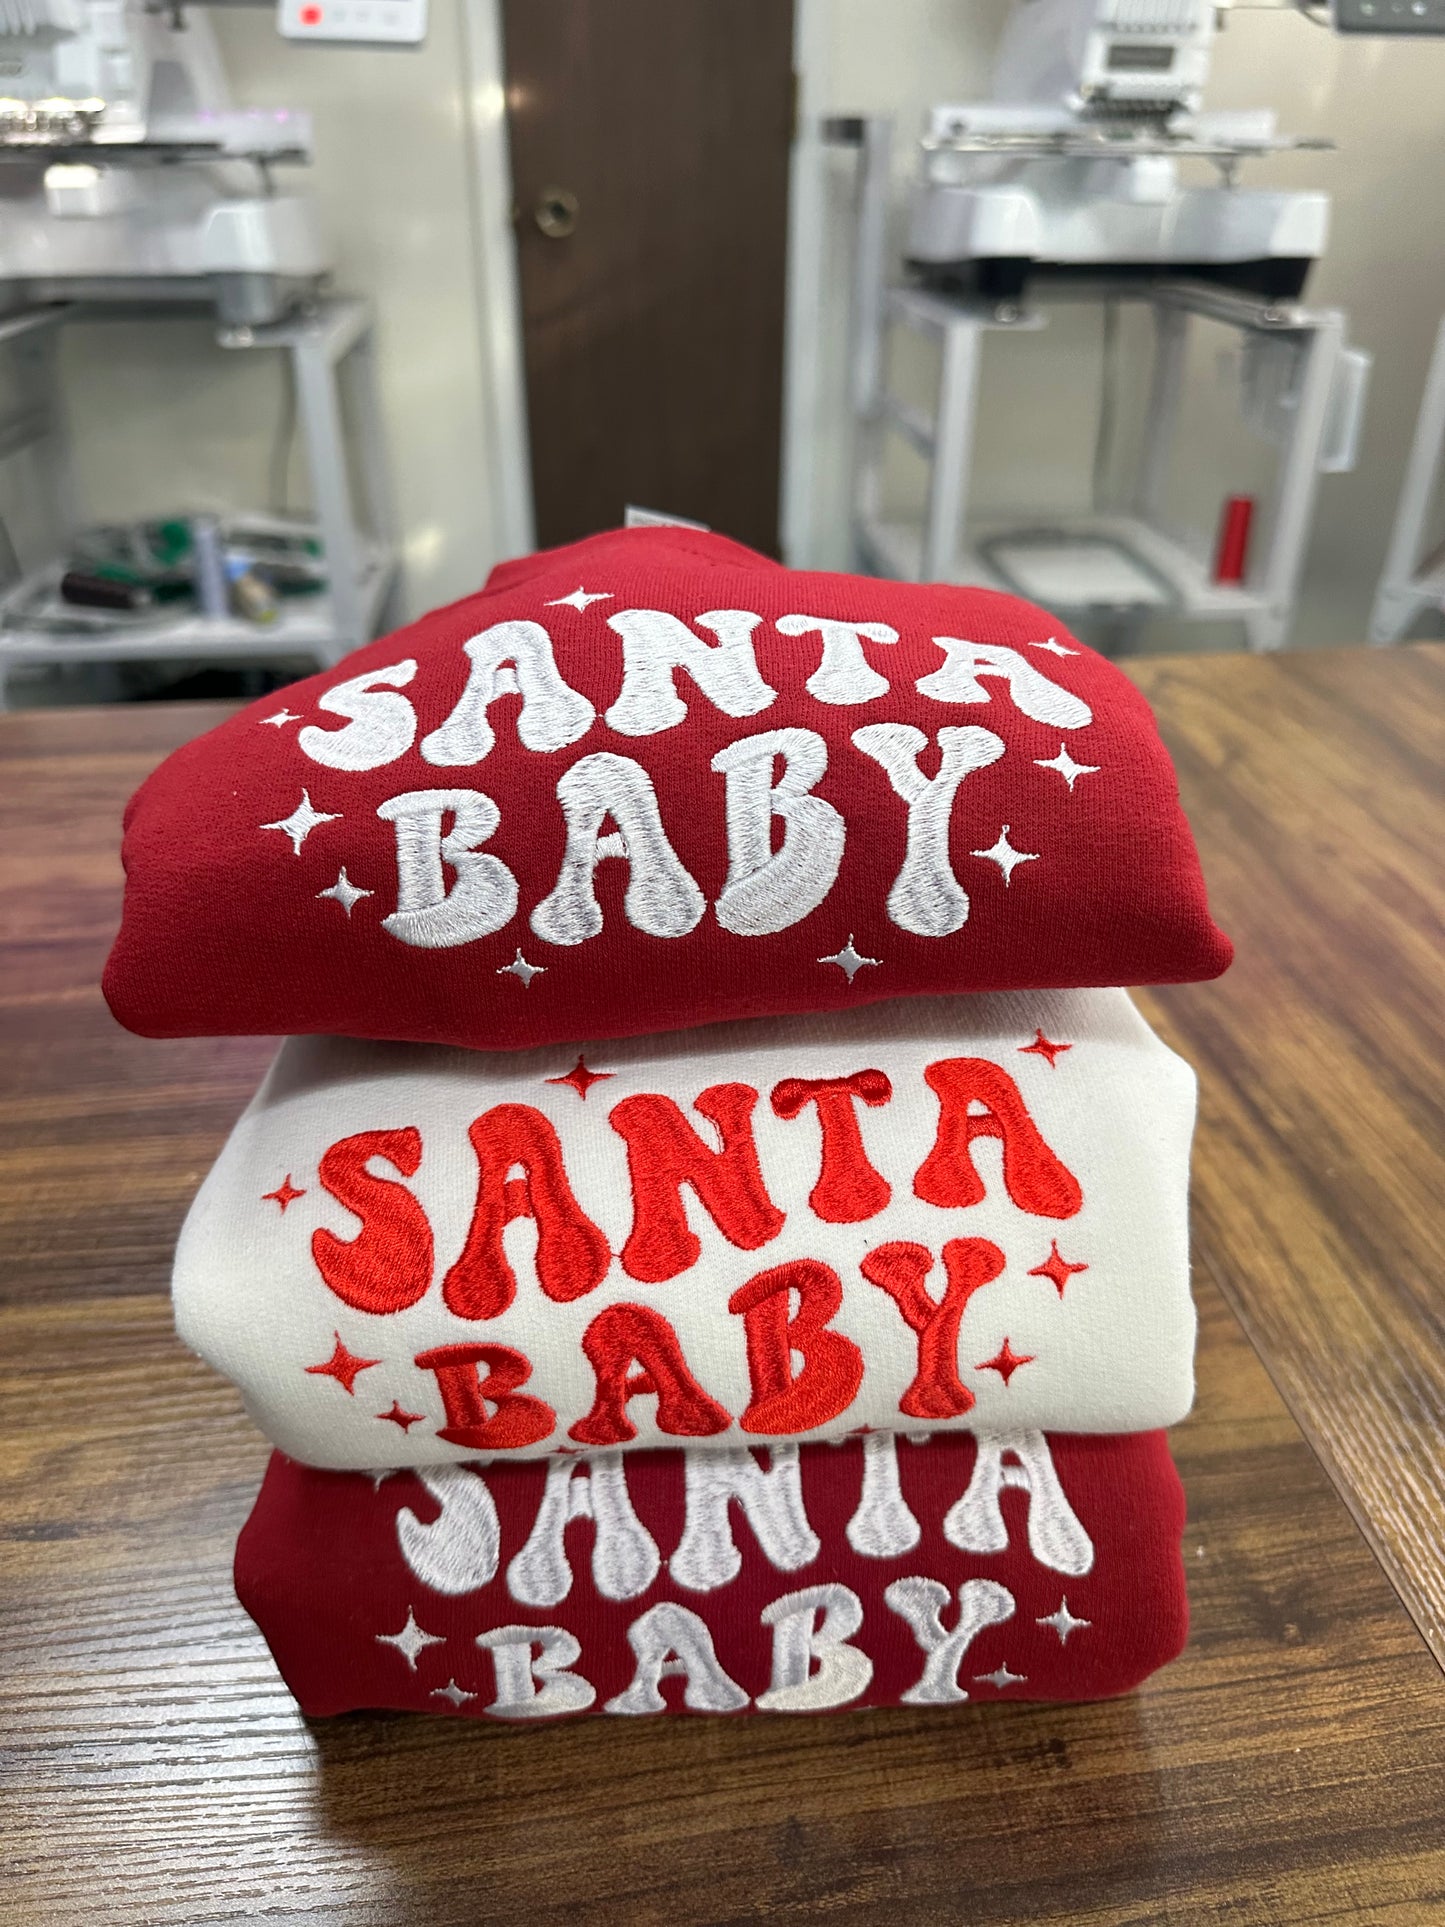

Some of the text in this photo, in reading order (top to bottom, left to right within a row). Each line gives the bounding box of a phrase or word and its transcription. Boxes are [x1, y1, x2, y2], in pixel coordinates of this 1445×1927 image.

[298, 608, 1093, 771] SANTA
[376, 722, 1005, 948] BABY
[311, 1057, 1083, 1320] SANTA
[414, 1237, 1006, 1449] BABY
[475, 1575, 1016, 1718] BABY
